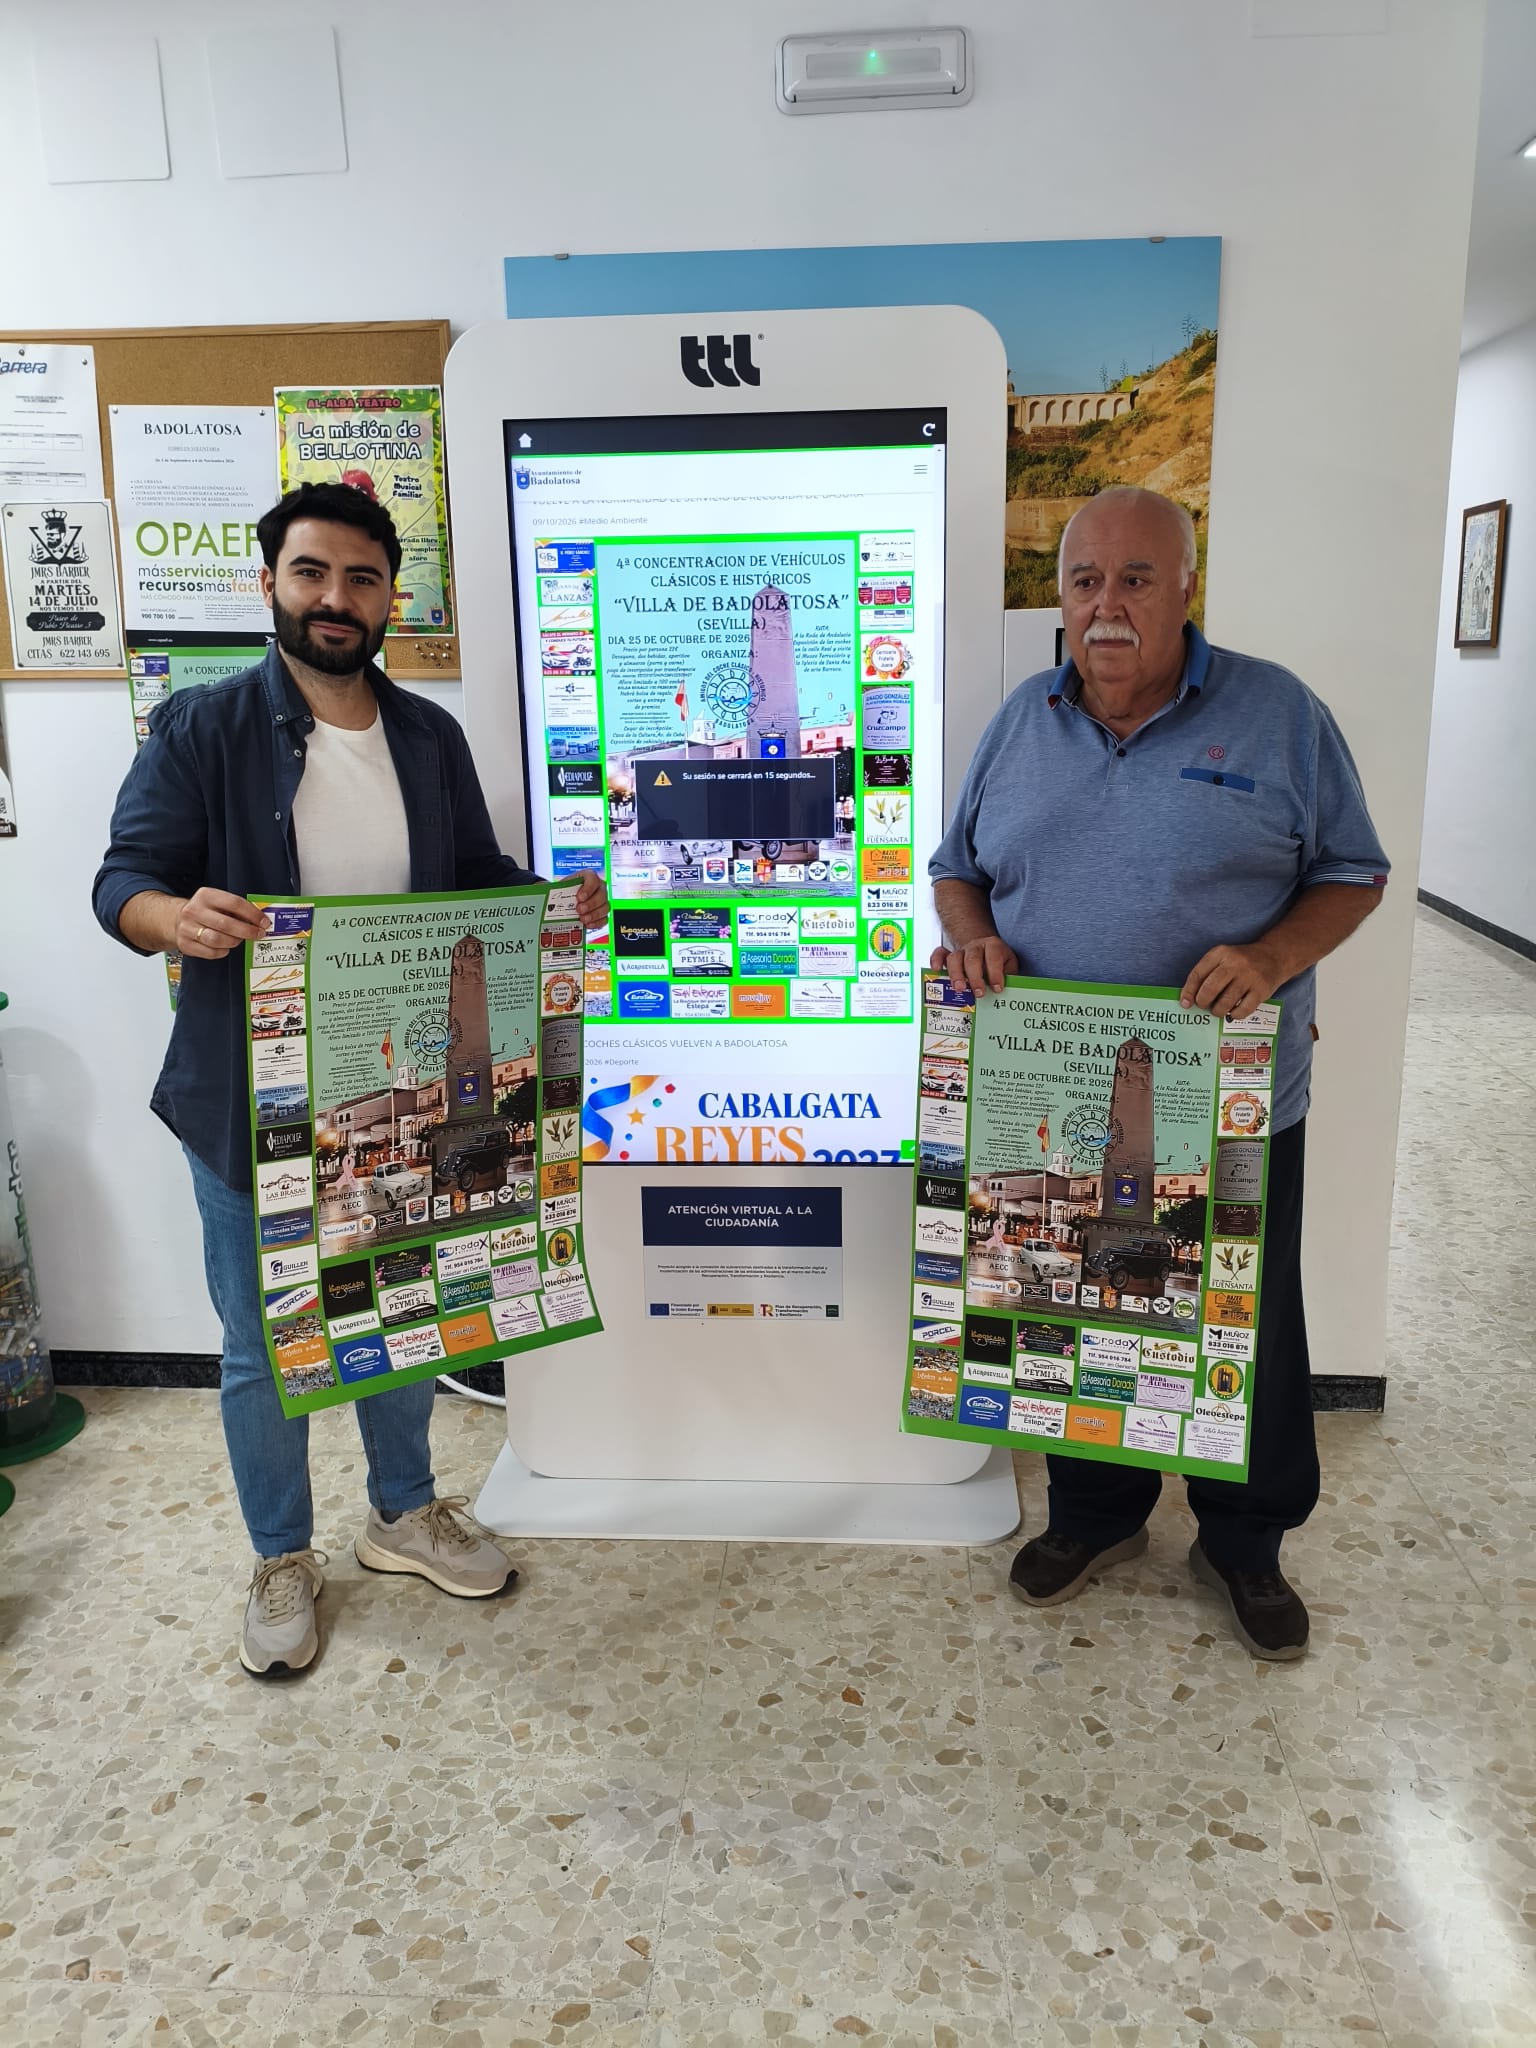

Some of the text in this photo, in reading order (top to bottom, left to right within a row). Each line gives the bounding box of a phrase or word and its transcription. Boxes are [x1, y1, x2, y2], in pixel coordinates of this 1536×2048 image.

[0, 362, 48, 373] arrera
[308, 398, 401, 408] AL-ALBA TEATRO
[144, 423, 242, 435] BADOLATOSA
[298, 420, 421, 438] La misión de
[299, 443, 422, 460] BELLOTINA
[394, 475, 419, 483] Teatro
[531, 477, 580, 485] Badolatosa
[394, 483, 422, 491] Musical
[533, 518, 577, 526] 09/10/2026
[610, 515, 648, 525] Ambiente
[616, 552, 846, 569] 4ª CONCENTRACION DE VEHÍCULOS
[31, 567, 90, 579] JMRS BARBER
[651, 571, 811, 587] CLÁSICOS E HISTÓRICOS
[35, 585, 90, 596] MARTES
[29, 596, 98, 606] 14 DE JULIO
[683, 597, 706, 612] DE
[697, 617, 766, 631] (SEVILLA)
[43, 636, 93, 647] JMRS BARBER
[608, 634, 750, 645] DIA 25 DE OCTUBRE DE 2026
[27, 649, 110, 659] CITAS 622 143 695
[701, 649, 759, 660] ORGANIZA:
[683, 772, 692, 780] Su
[694, 772, 716, 780] sesión
[776, 772, 816, 780] segundos...
[866, 836, 908, 844] FUENSANTA
[882, 887, 908, 896] MUÑOZ
[332, 905, 535, 929] 4ª CONCENTRACION DE VEHÍCULOS
[801, 918, 855, 929] Custodio
[362, 922, 505, 943] CLÁSICOS E HISTÓRICOS
[262, 954, 300, 963] LANZAS
[391, 949, 412, 964] DE
[403, 965, 464, 981] (SEVILLA)
[318, 981, 450, 1002] DIA 25 DE OCTUBRE DE 2026
[405, 995, 456, 1007] ORGANIZA:
[994, 999, 1210, 1025] 4ª CONCENTRACION DE VEHÍCULOS
[934, 1025, 966, 1034] LANZAS
[1024, 1017, 1175, 1041] CLÁSICOS E HISTÓRICOS
[622, 1038, 668, 1048] CLÁSICOS
[670, 1039, 713, 1048] VUELVEN
[715, 1039, 722, 1047] A
[724, 1039, 788, 1048] BADOLATOSA
[1052, 1040, 1073, 1055] DE
[605, 1058, 639, 1067] #Deporte
[1064, 1060, 1129, 1078] (SEVILLA)
[980, 1068, 1112, 1088] DIA 25 DE OCTUBRE DE 2026
[1065, 1090, 1119, 1102] ORGANIZA:
[698, 1092, 882, 1119] CABALGATA
[655, 1126, 806, 1162] REYES
[544, 1151, 577, 1162] FUENSANTA
[328, 1189, 367, 1203] BENEFICIO
[341, 1201, 362, 1210] AECC
[668, 1203, 813, 1215] ATENCIÓN VIRTUAL A LA
[705, 1216, 779, 1228] CIUDADANÍA
[492, 1234, 536, 1253] Custodio
[978, 1253, 1015, 1263] BENEFICIO
[989, 1262, 1009, 1271] AECC
[544, 1274, 584, 1288] Oleoestepa
[1212, 1281, 1254, 1290] FUENSANTA
[276, 1289, 312, 1313] PORCEL
[1223, 1331, 1250, 1340] MUÑOZ
[1142, 1348, 1195, 1363] Custodio
[1196, 1407, 1245, 1421] Oleoestepa
